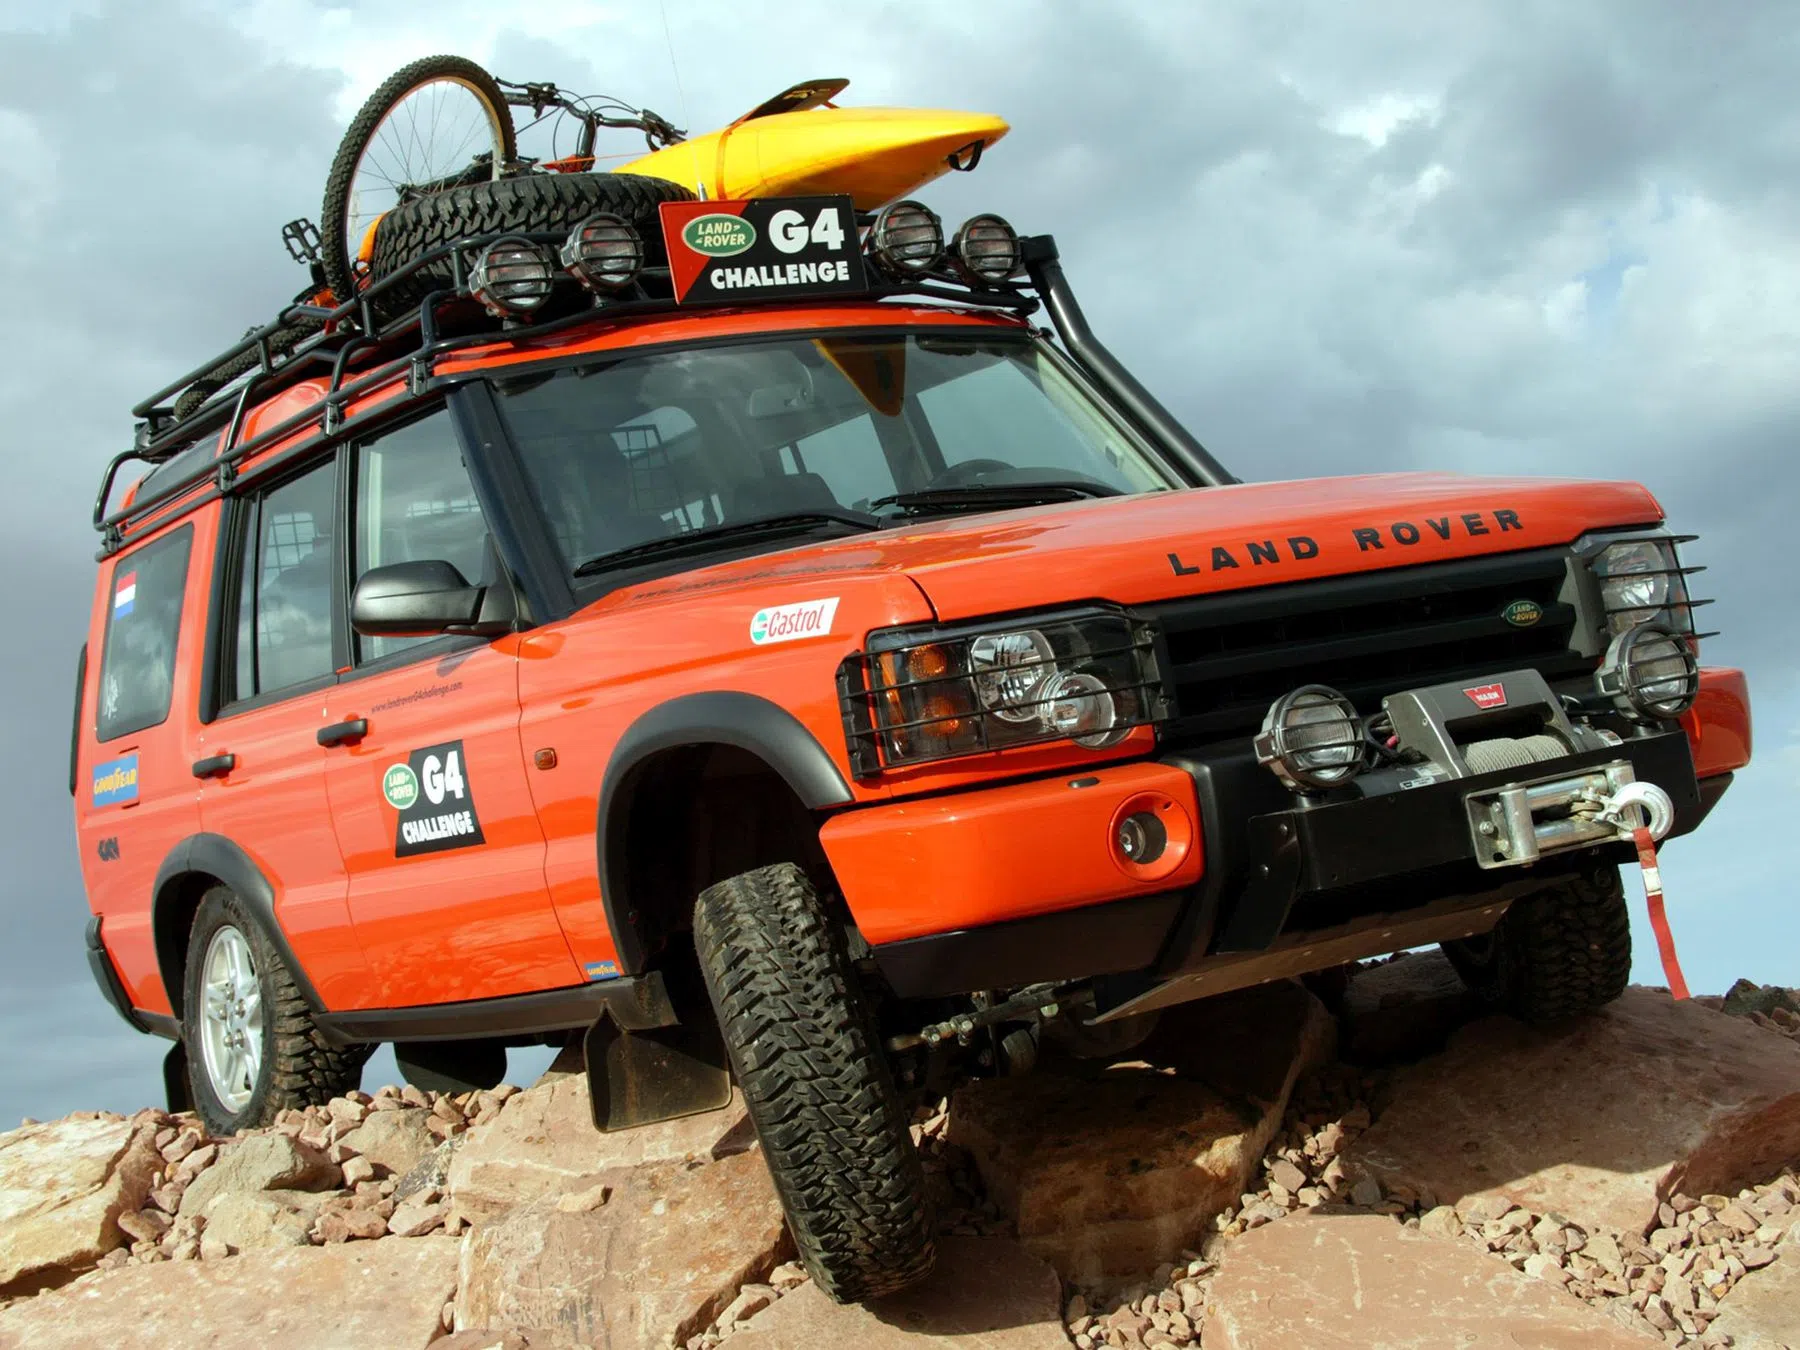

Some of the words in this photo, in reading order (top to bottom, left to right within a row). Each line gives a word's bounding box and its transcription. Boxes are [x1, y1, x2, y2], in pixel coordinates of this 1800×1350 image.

[698, 222, 732, 235] LAND
[704, 233, 746, 247] ROVER
[769, 208, 844, 254] G4
[710, 261, 850, 290] CHALLENGE
[1167, 536, 1320, 576] LAND
[1352, 509, 1524, 552] ROVER
[768, 604, 825, 637] Castrol
[94, 766, 137, 796] GOODYEAR
[422, 750, 464, 804] G4
[402, 811, 475, 844] CHALLENGE
